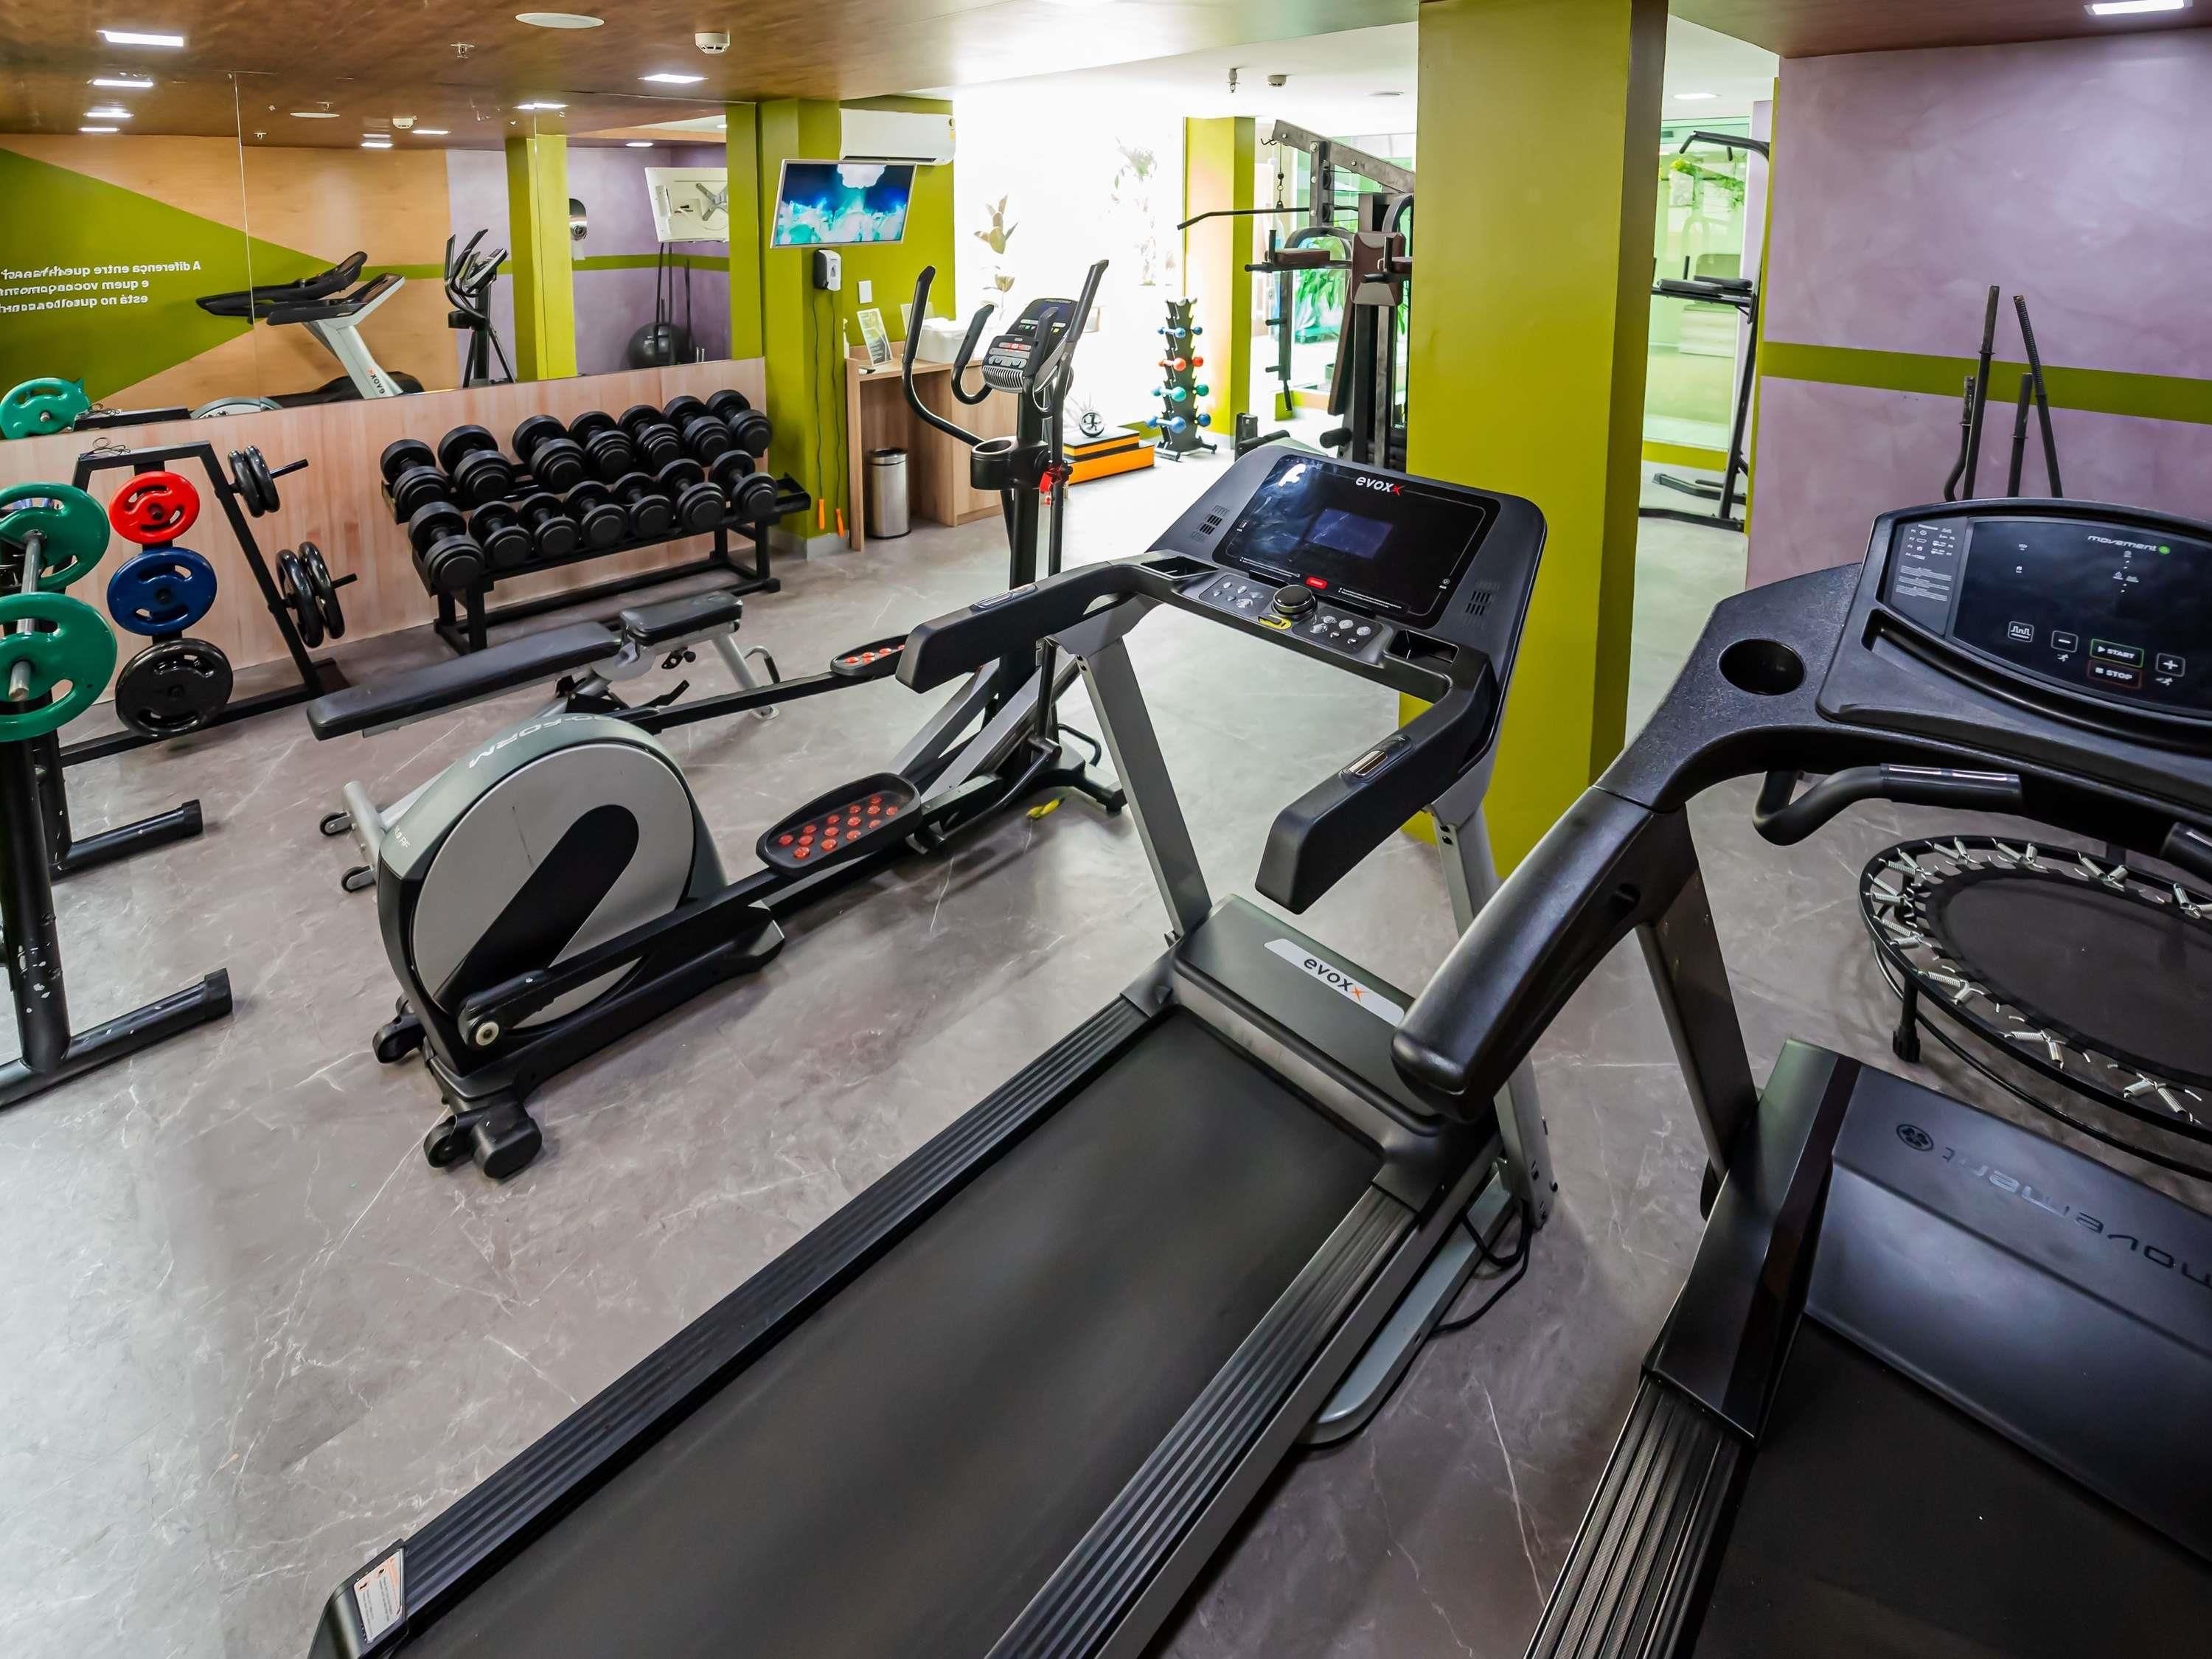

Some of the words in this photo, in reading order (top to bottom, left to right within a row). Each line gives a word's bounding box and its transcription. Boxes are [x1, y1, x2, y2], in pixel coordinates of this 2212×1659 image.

[2087, 535, 2157, 552] movement
[2107, 648, 2135, 659] START
[2106, 669, 2133, 680] STOP
